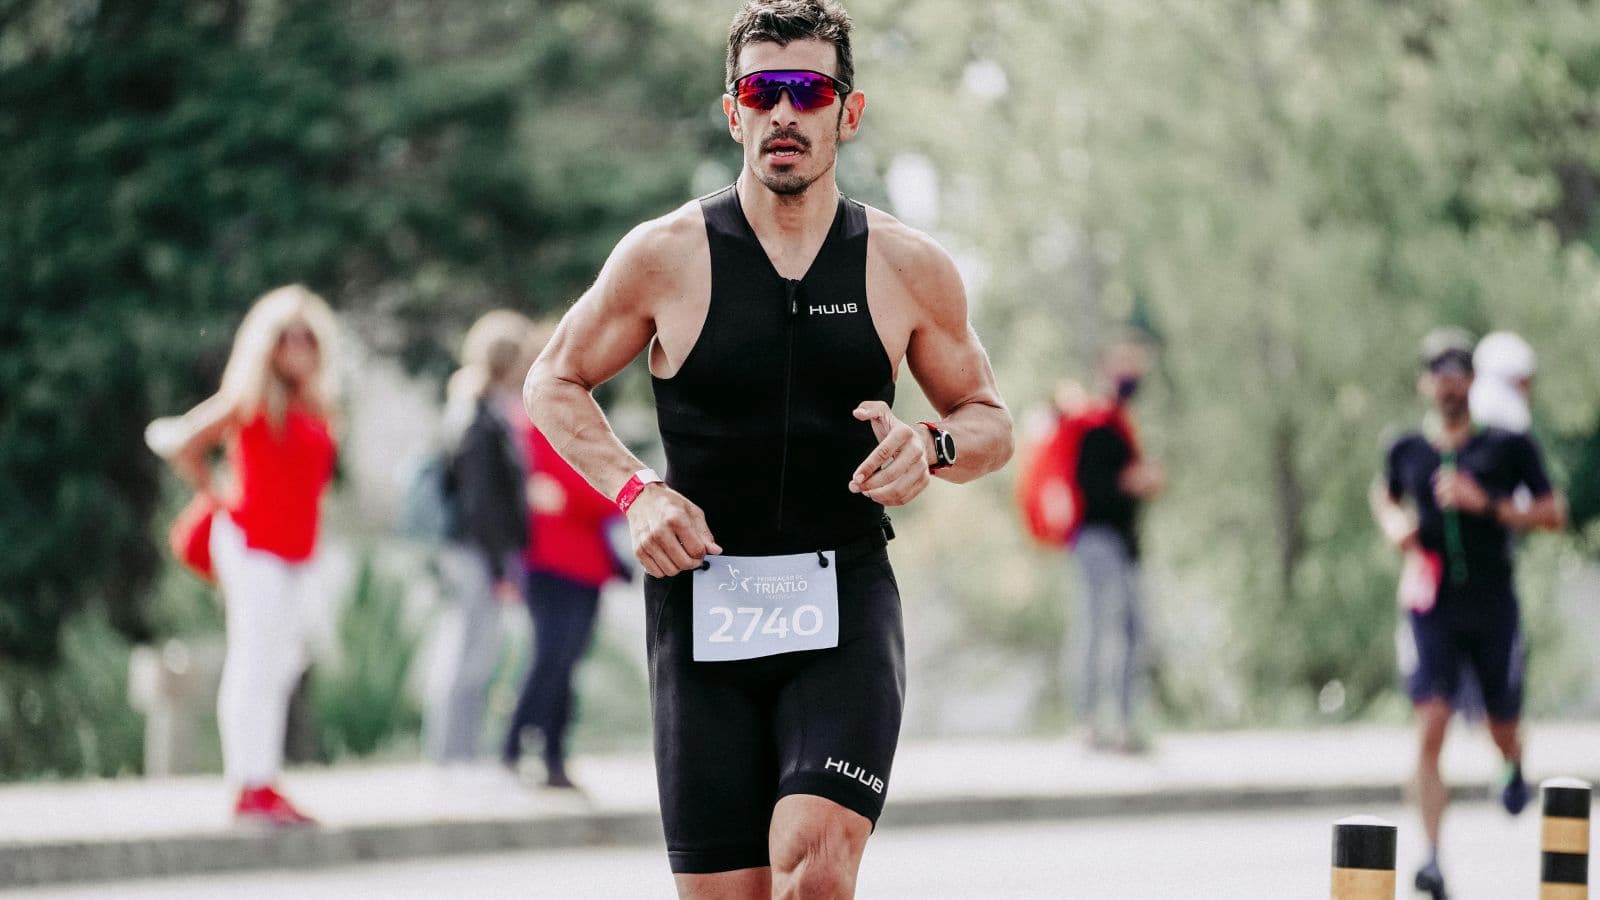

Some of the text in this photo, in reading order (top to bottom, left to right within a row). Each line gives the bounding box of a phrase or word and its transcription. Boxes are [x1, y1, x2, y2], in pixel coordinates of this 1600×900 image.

[809, 303, 858, 315] HUUB
[753, 580, 808, 594] TRIATLO
[708, 604, 824, 643] 2740
[824, 756, 884, 794] HUUB
